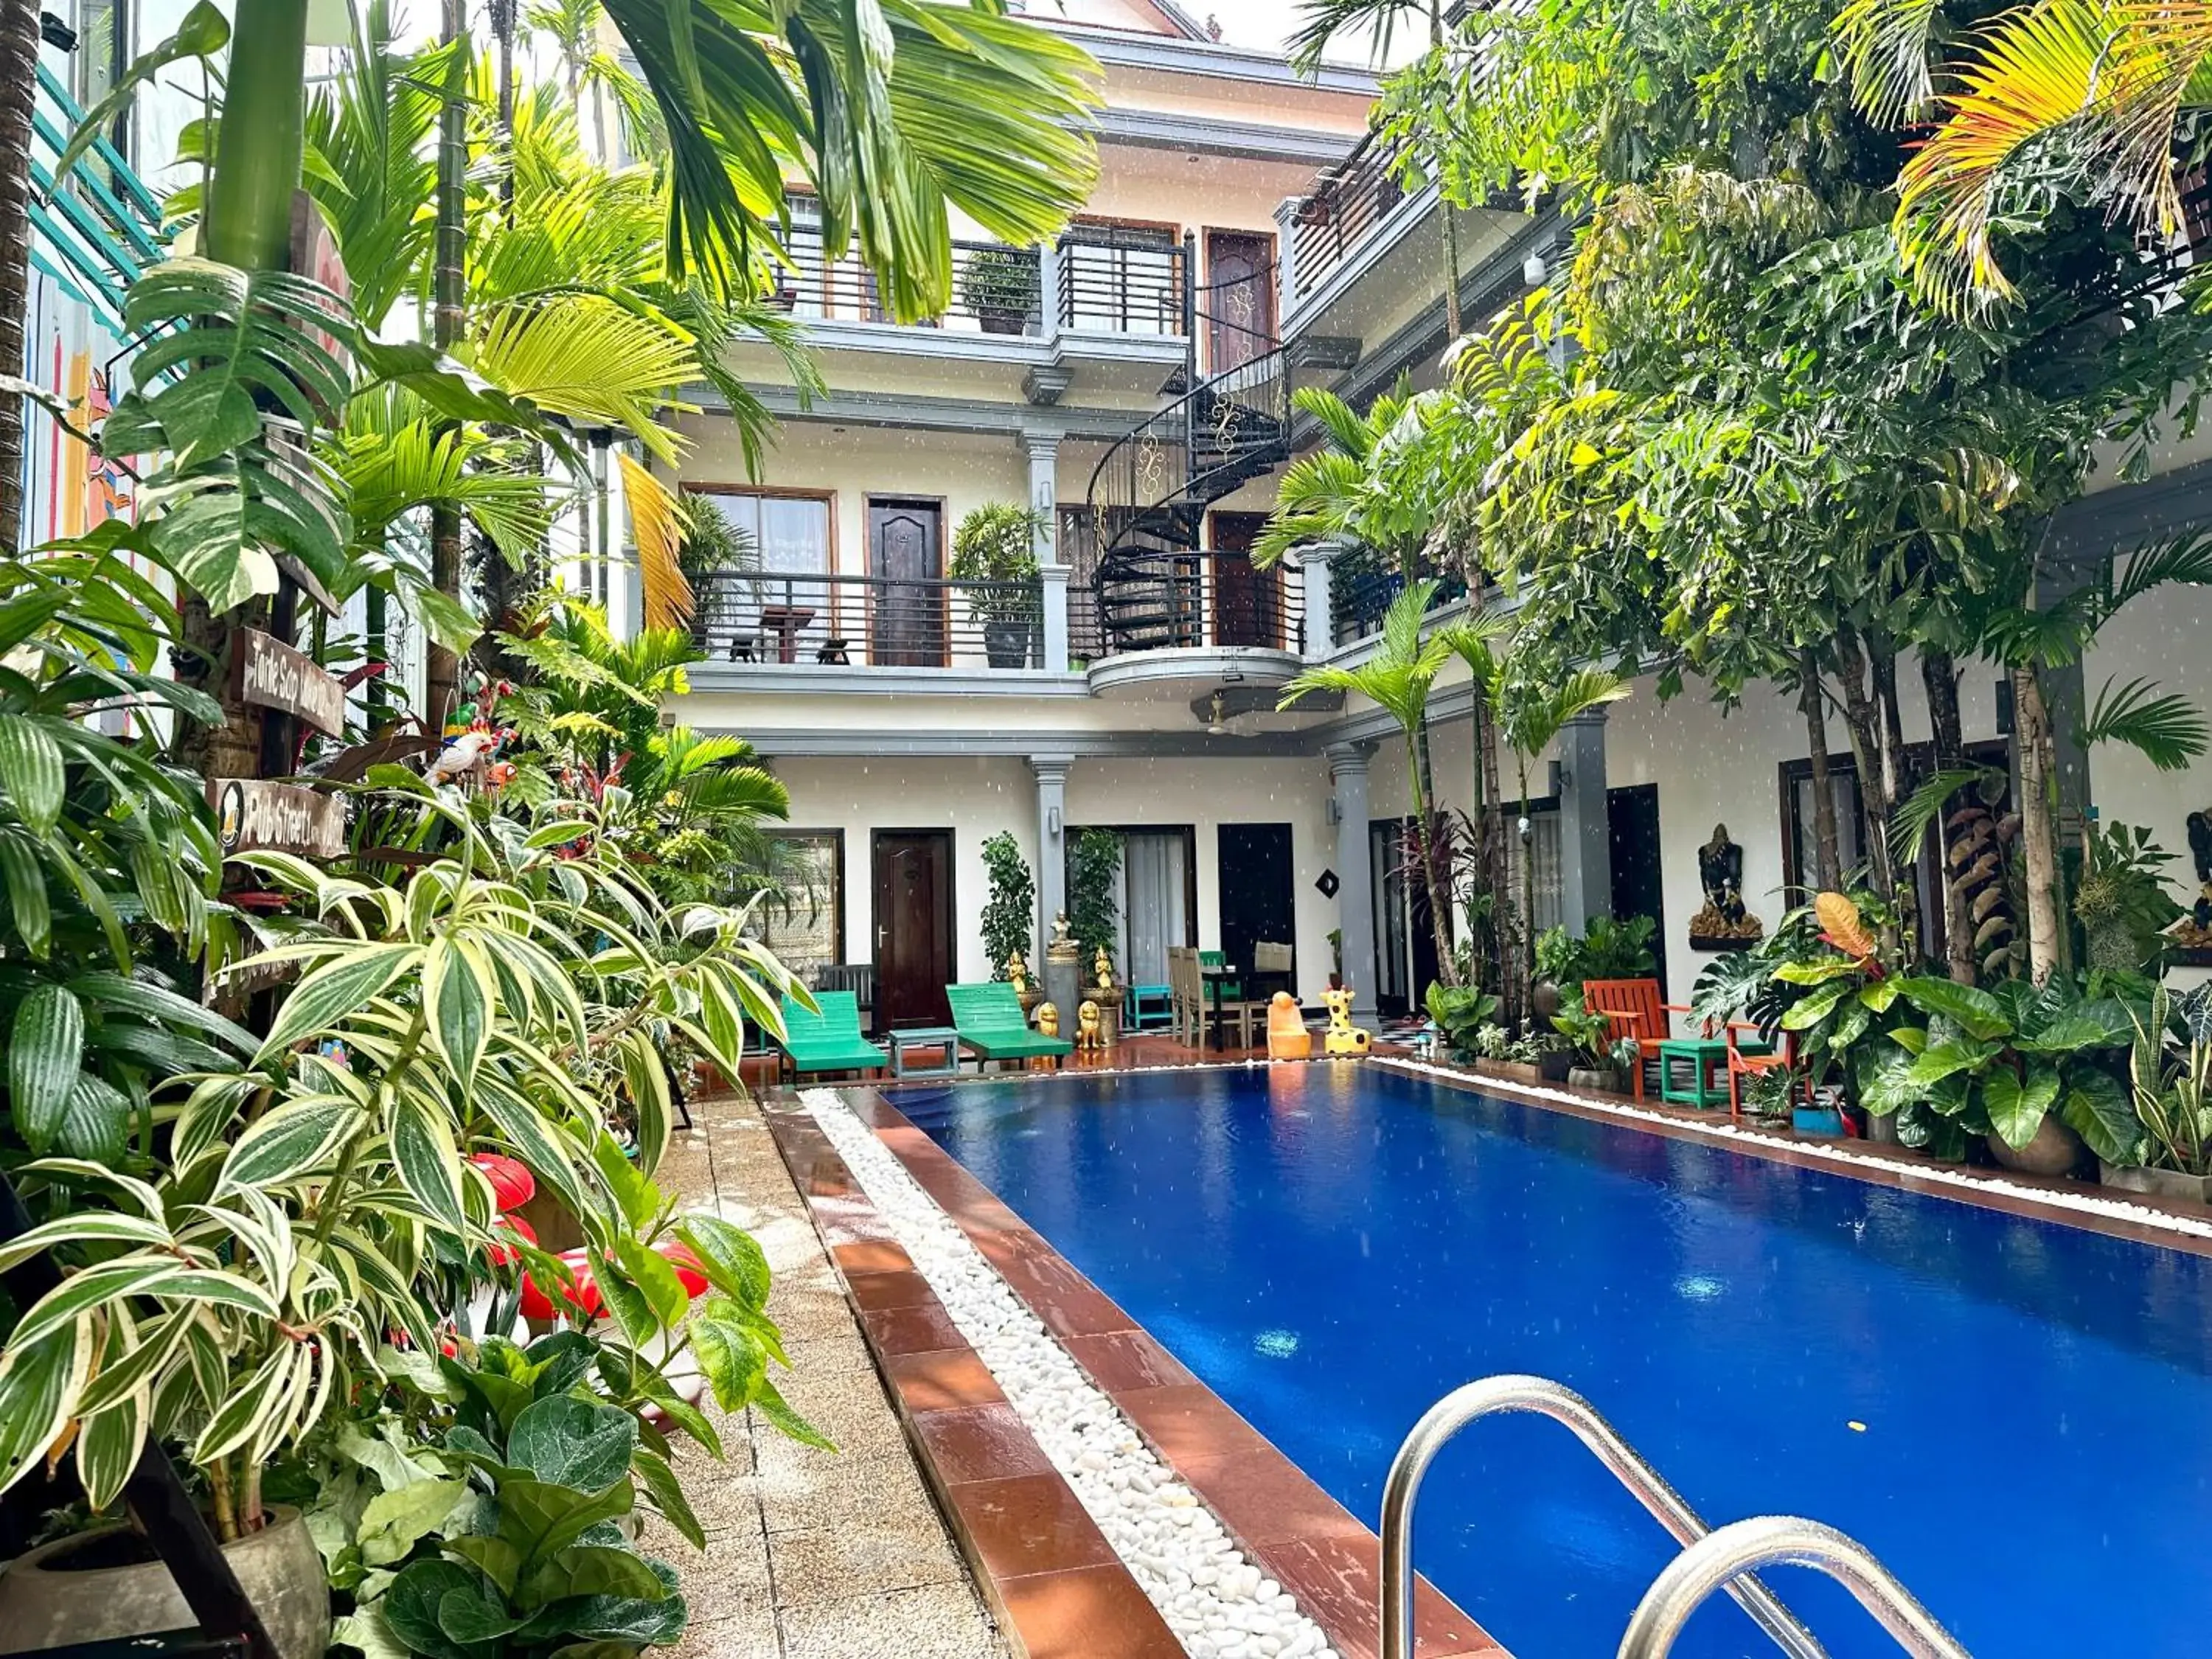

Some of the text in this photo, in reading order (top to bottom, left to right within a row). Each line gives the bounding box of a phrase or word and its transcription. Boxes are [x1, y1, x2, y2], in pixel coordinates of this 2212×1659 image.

[279, 654, 299, 713] Sap
[246, 790, 274, 845] Pub
[275, 796, 307, 847] Street
